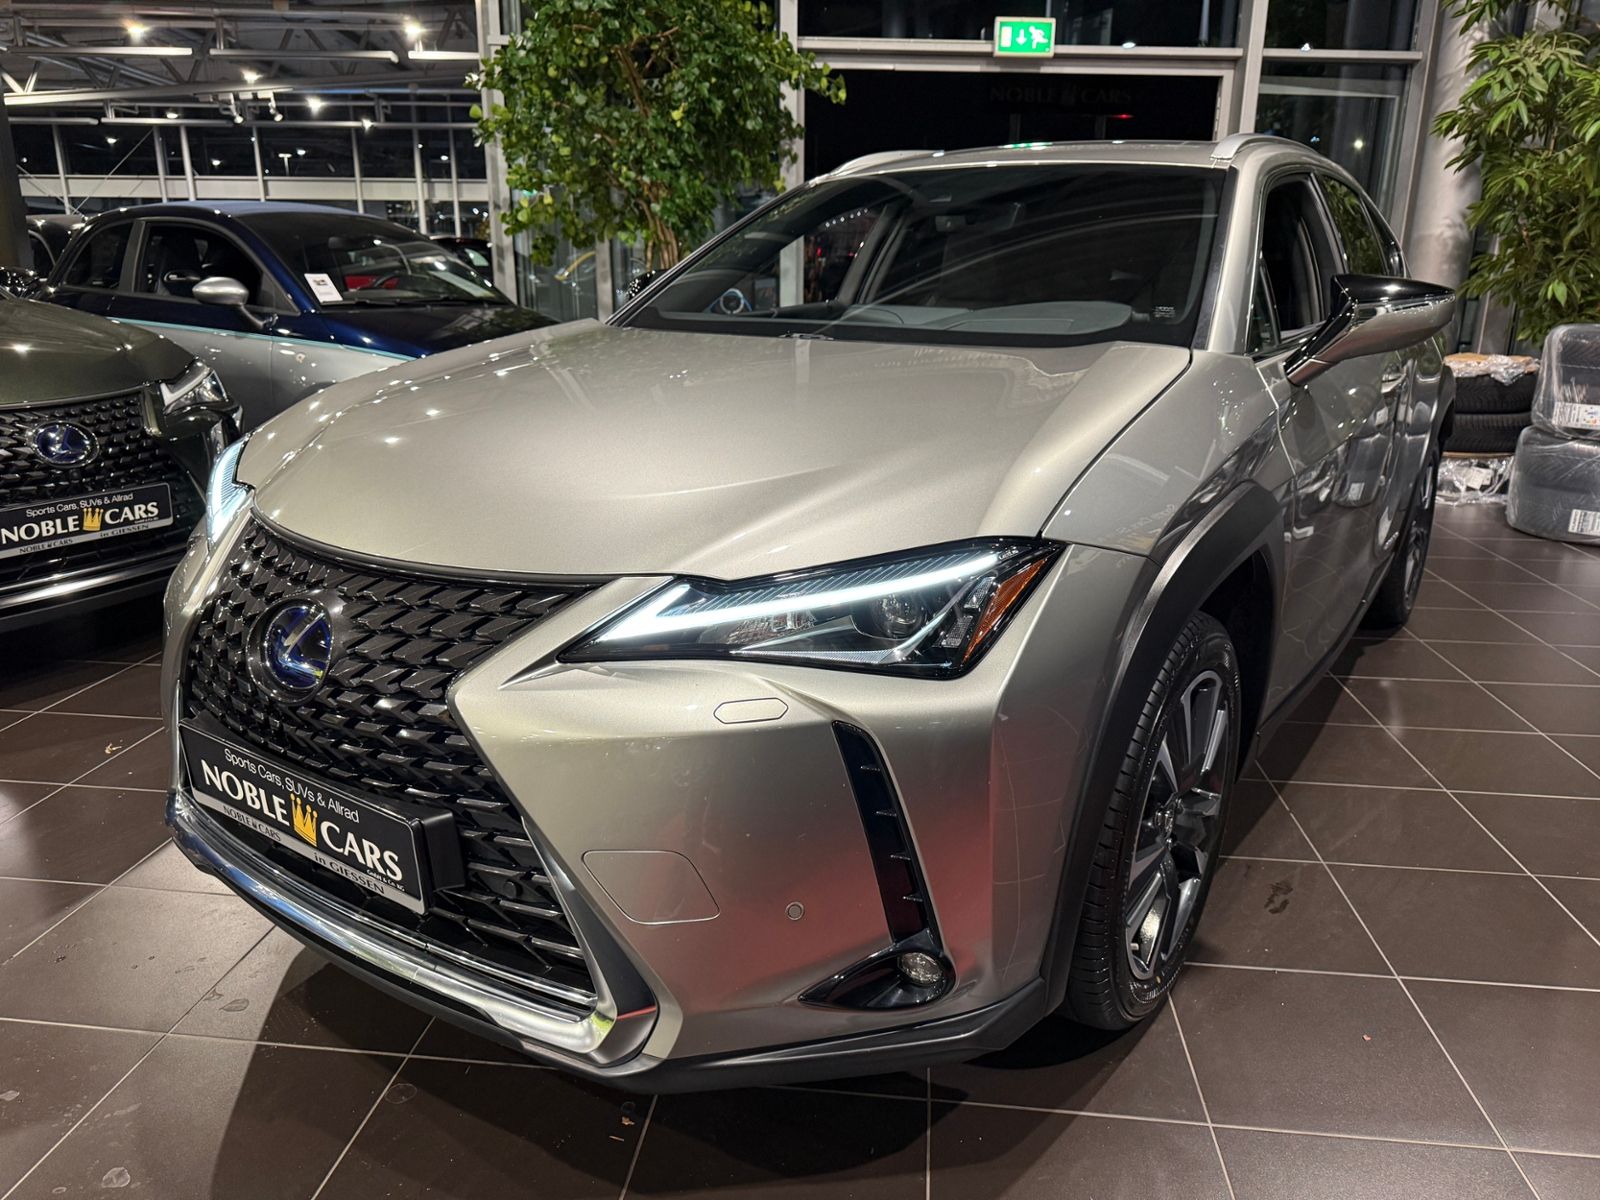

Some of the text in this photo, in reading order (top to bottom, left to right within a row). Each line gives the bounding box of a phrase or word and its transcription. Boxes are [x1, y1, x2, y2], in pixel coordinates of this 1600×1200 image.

[990, 87, 1132, 104] NOBLE CARS
[0, 502, 159, 544] NOBLE CARS
[26, 506, 55, 518] Sports
[80, 498, 102, 509] SUVs
[111, 493, 134, 503] Allrad
[112, 524, 149, 535] GIESSEN
[224, 748, 359, 823] Sports Cars, SUVs & Allrad
[201, 759, 403, 881] NOBLE CARS
[223, 805, 281, 841] NOBLE CARS
[314, 852, 385, 894] in GIESSEN
